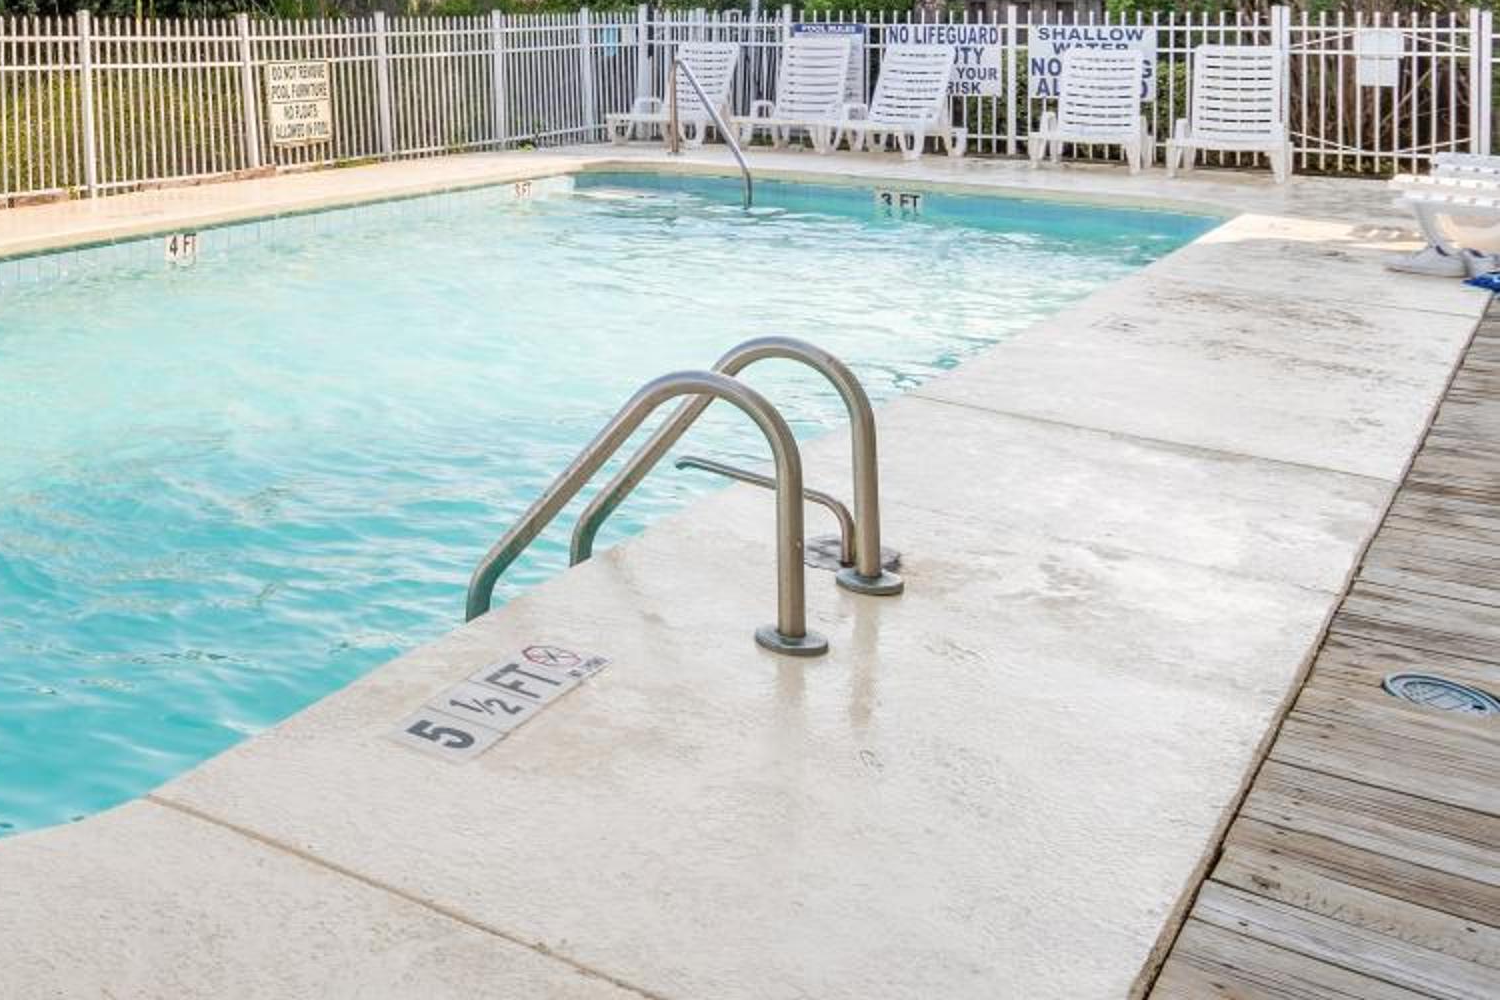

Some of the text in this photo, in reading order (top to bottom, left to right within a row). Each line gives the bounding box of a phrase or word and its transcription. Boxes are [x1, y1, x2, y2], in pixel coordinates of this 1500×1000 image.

[888, 26, 998, 44] NO LIFEGUARD
[1038, 27, 1144, 41] SHALLOW
[956, 67, 997, 80] YOUR
[1031, 58, 1062, 76] NO
[272, 82, 327, 99] POOL FURNITURE
[900, 193, 920, 208] FT
[170, 233, 196, 256] 4 FT
[405, 719, 475, 749] 5
[485, 663, 562, 699] FT
